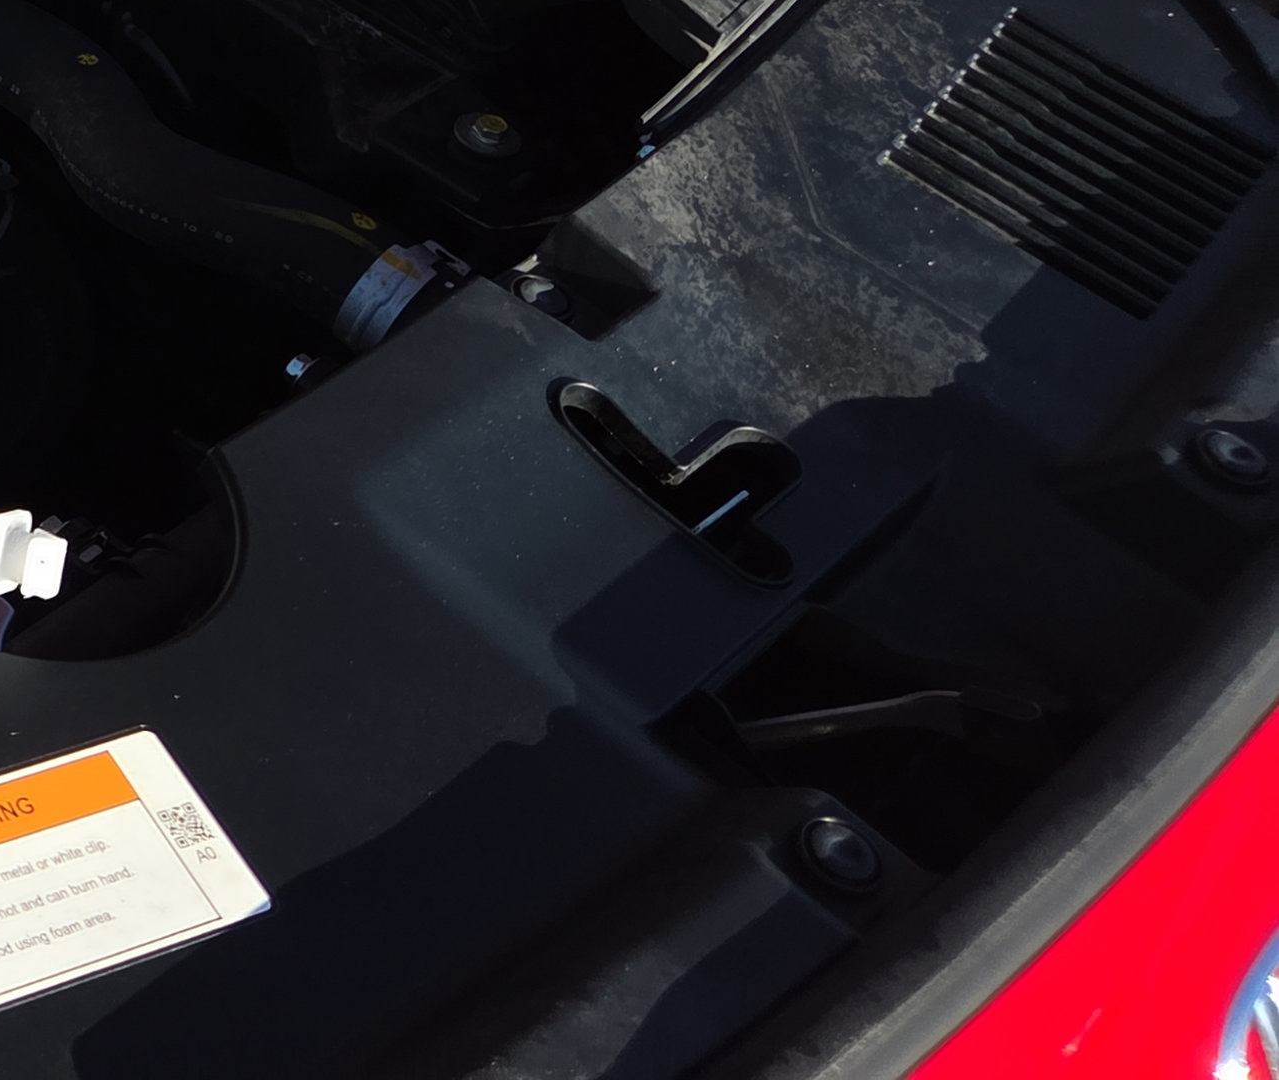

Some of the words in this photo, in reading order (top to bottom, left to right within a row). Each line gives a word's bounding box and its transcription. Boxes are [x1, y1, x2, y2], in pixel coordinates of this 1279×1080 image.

[1, 861, 35, 883] metal
[36, 857, 49, 870] or
[50, 848, 83, 866] white
[21, 896, 45, 913] and
[45, 889, 69, 904] can
[69, 878, 99, 895] burn
[15, 931, 50, 952] using
[50, 921, 83, 940] foam
